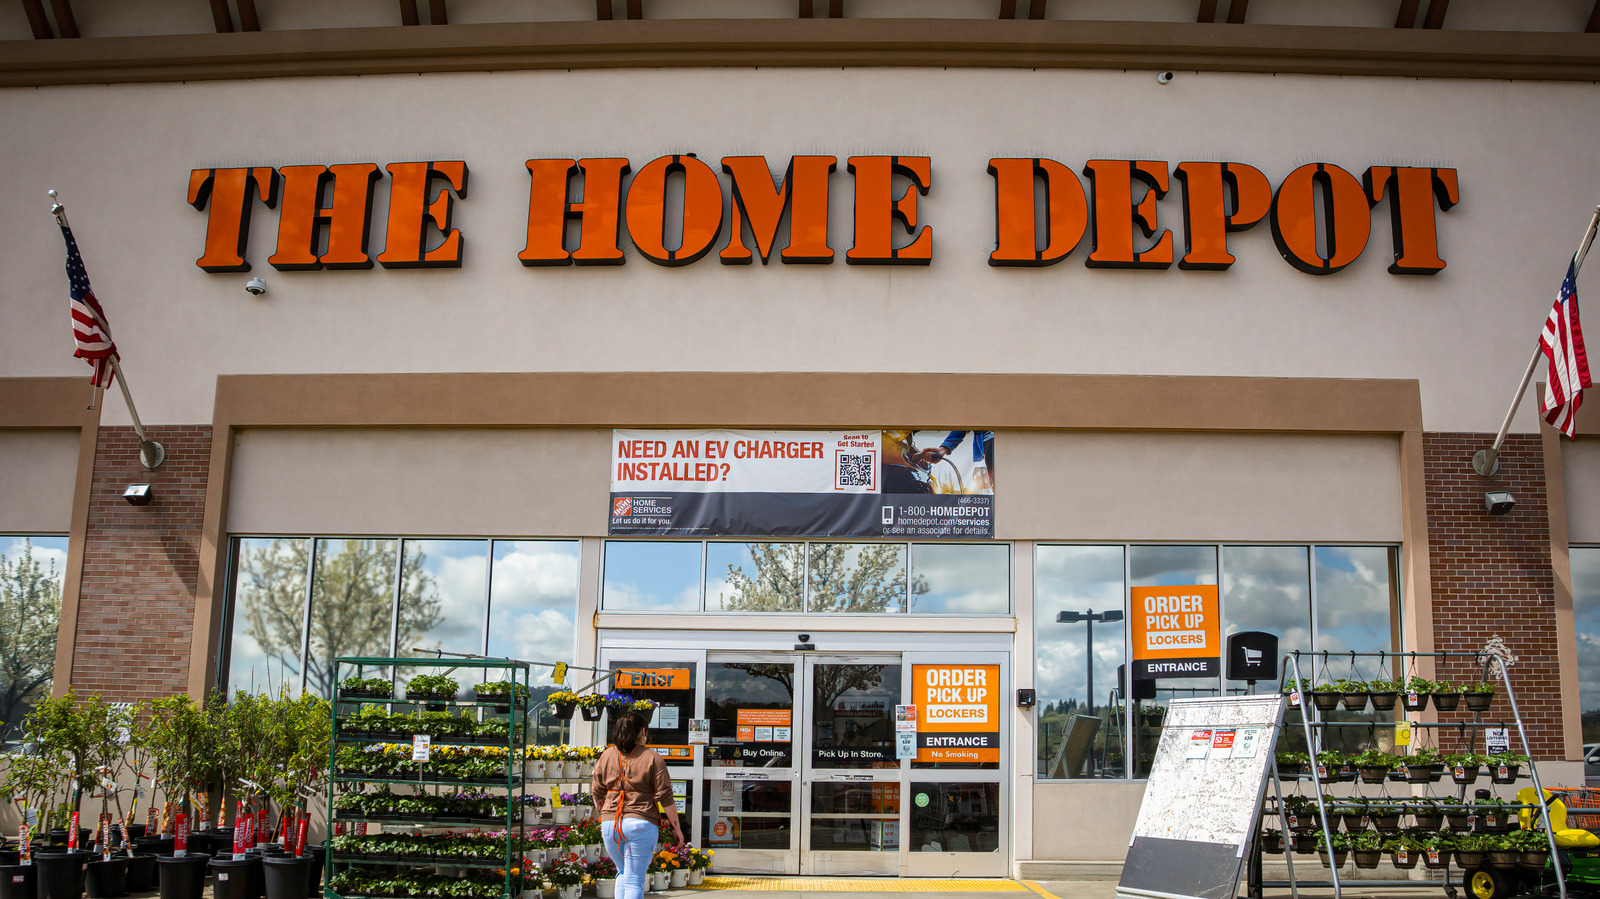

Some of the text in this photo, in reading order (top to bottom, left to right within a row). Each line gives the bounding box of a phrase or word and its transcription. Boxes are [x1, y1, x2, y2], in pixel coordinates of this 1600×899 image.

[187, 154, 1460, 275] THE HOME DEPOT
[618, 440, 824, 459] NEED AN EV CHARGER
[617, 462, 731, 481] INSTALLED?
[633, 506, 672, 514] SERVICES
[898, 506, 990, 517] 1-800-HOMEDEPOT
[897, 517, 990, 527] homedepot.com/services
[964, 527, 990, 535] details.
[1144, 595, 1204, 614] ORDER
[1146, 614, 1204, 630] PICK UP
[1149, 634, 1204, 645] LOCKERS
[1147, 662, 1208, 673] ENTRANCE
[926, 669, 987, 687] ORDER
[927, 687, 987, 703] PICK UP
[929, 709, 985, 718] LOCKERS
[926, 737, 988, 746] ENTRANCE
[742, 749, 786, 758] Buy Online.
[837, 751, 849, 759] Up
[945, 751, 978, 759] Smoking
